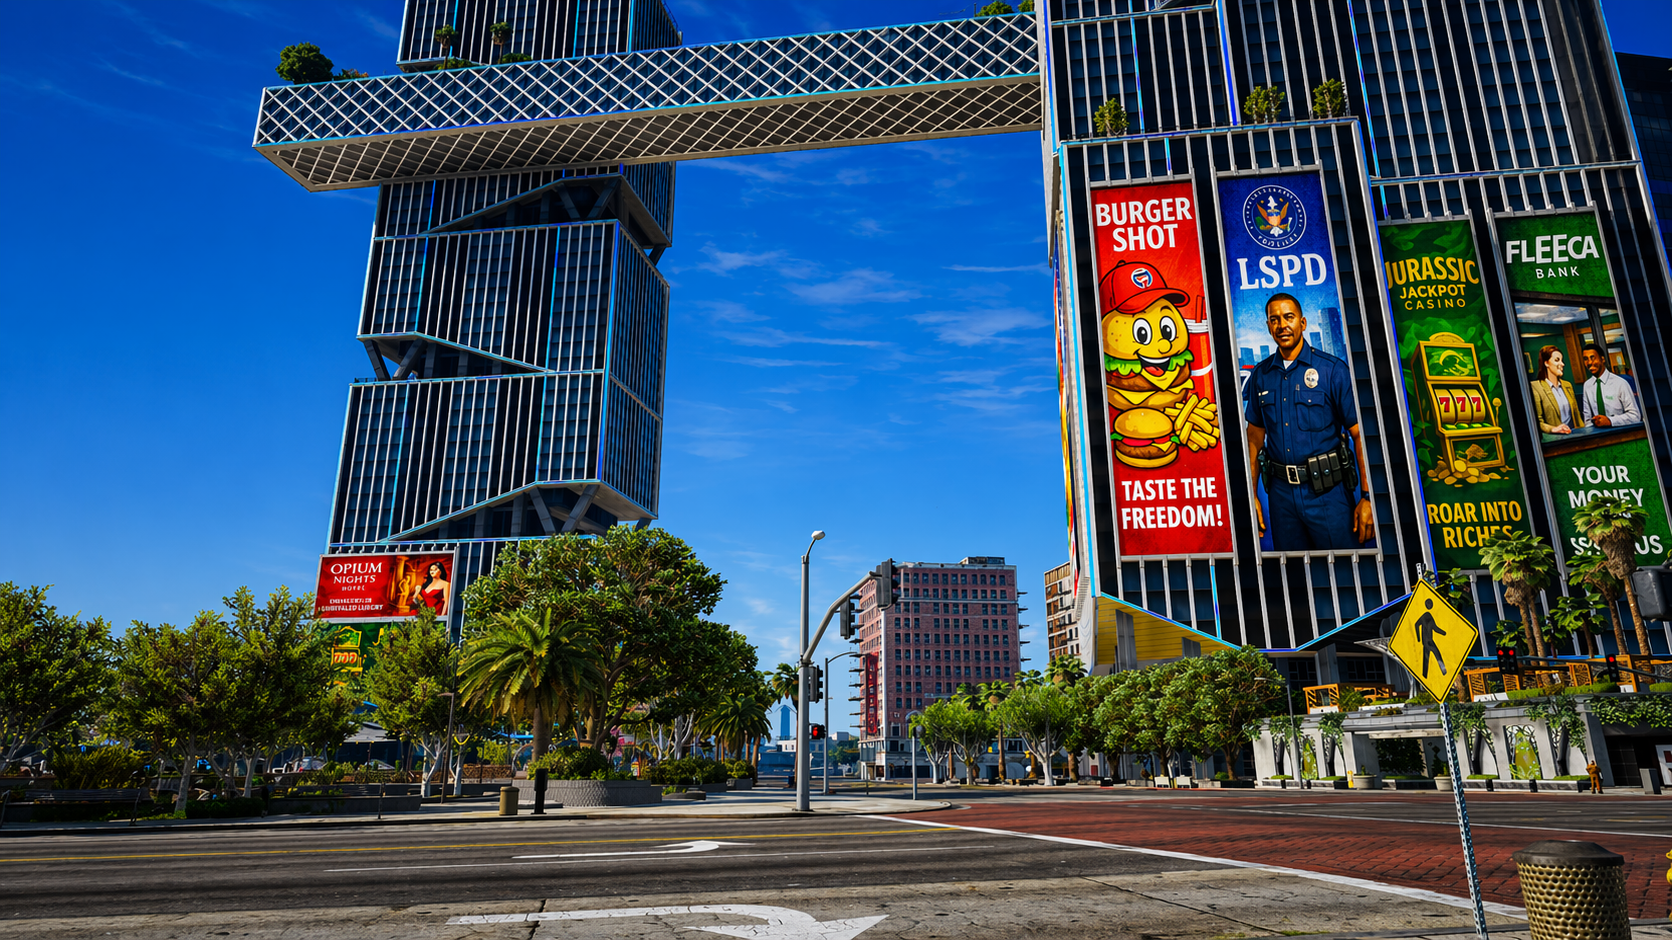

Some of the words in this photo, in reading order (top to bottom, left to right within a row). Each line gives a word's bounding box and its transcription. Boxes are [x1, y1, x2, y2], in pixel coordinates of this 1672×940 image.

[1096, 197, 1193, 227] BURGER
[1113, 223, 1178, 252] SHOT
[1506, 233, 1600, 264] FLEECA
[1237, 253, 1327, 290] LSPD
[1385, 256, 1480, 290] JURASSIC
[1535, 265, 1580, 280] BANK
[1400, 284, 1467, 300] JACKPOT
[1404, 298, 1466, 311] CASINO
[1571, 465, 1631, 485] YOUR
[1122, 479, 1177, 502] TASTE
[1180, 476, 1217, 499] THE
[1122, 504, 1223, 530] FREEDOM!
[1427, 502, 1478, 524] ROAR
[1480, 500, 1522, 523] INTO
[330, 562, 382, 575] OPIUM
[333, 575, 376, 584] NIGHTS
